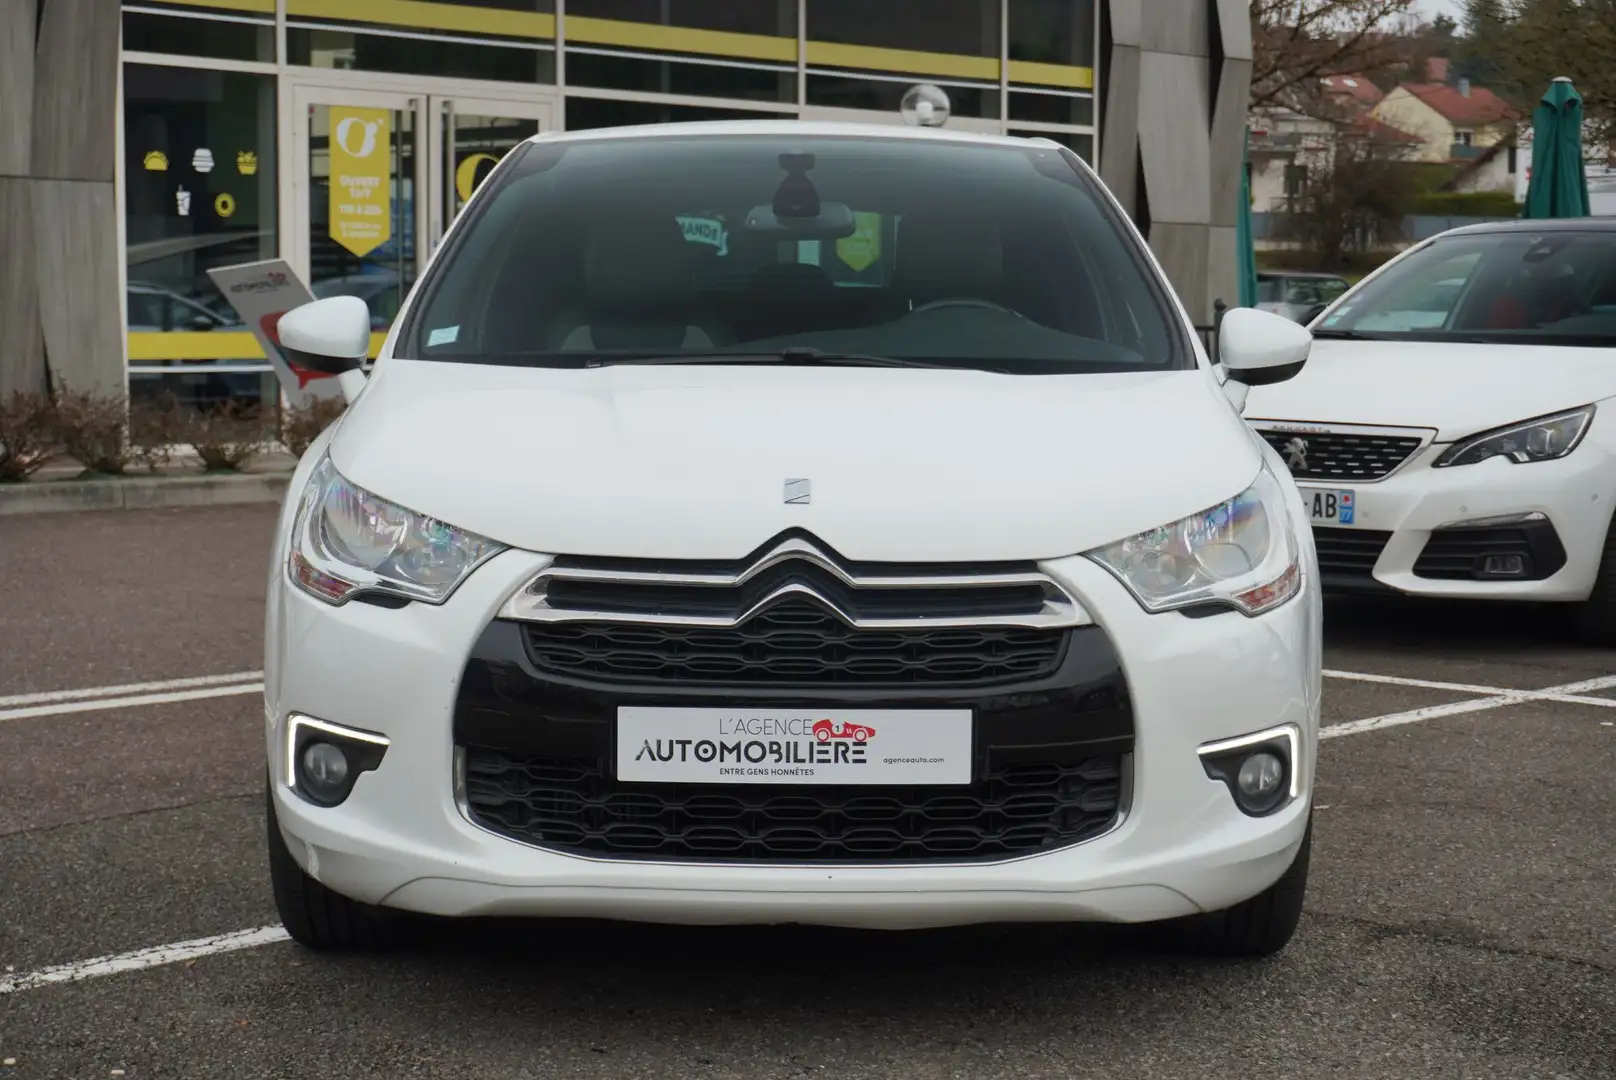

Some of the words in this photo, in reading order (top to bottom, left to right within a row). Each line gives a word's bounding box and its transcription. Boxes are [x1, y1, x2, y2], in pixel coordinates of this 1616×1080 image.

[719, 718, 813, 736] L'AGENCE
[882, 756, 945, 765] agenceauto.com
[719, 767, 745, 775] ENTRE
[747, 768, 769, 776] GENS
[771, 766, 815, 776] HONNÊTES
